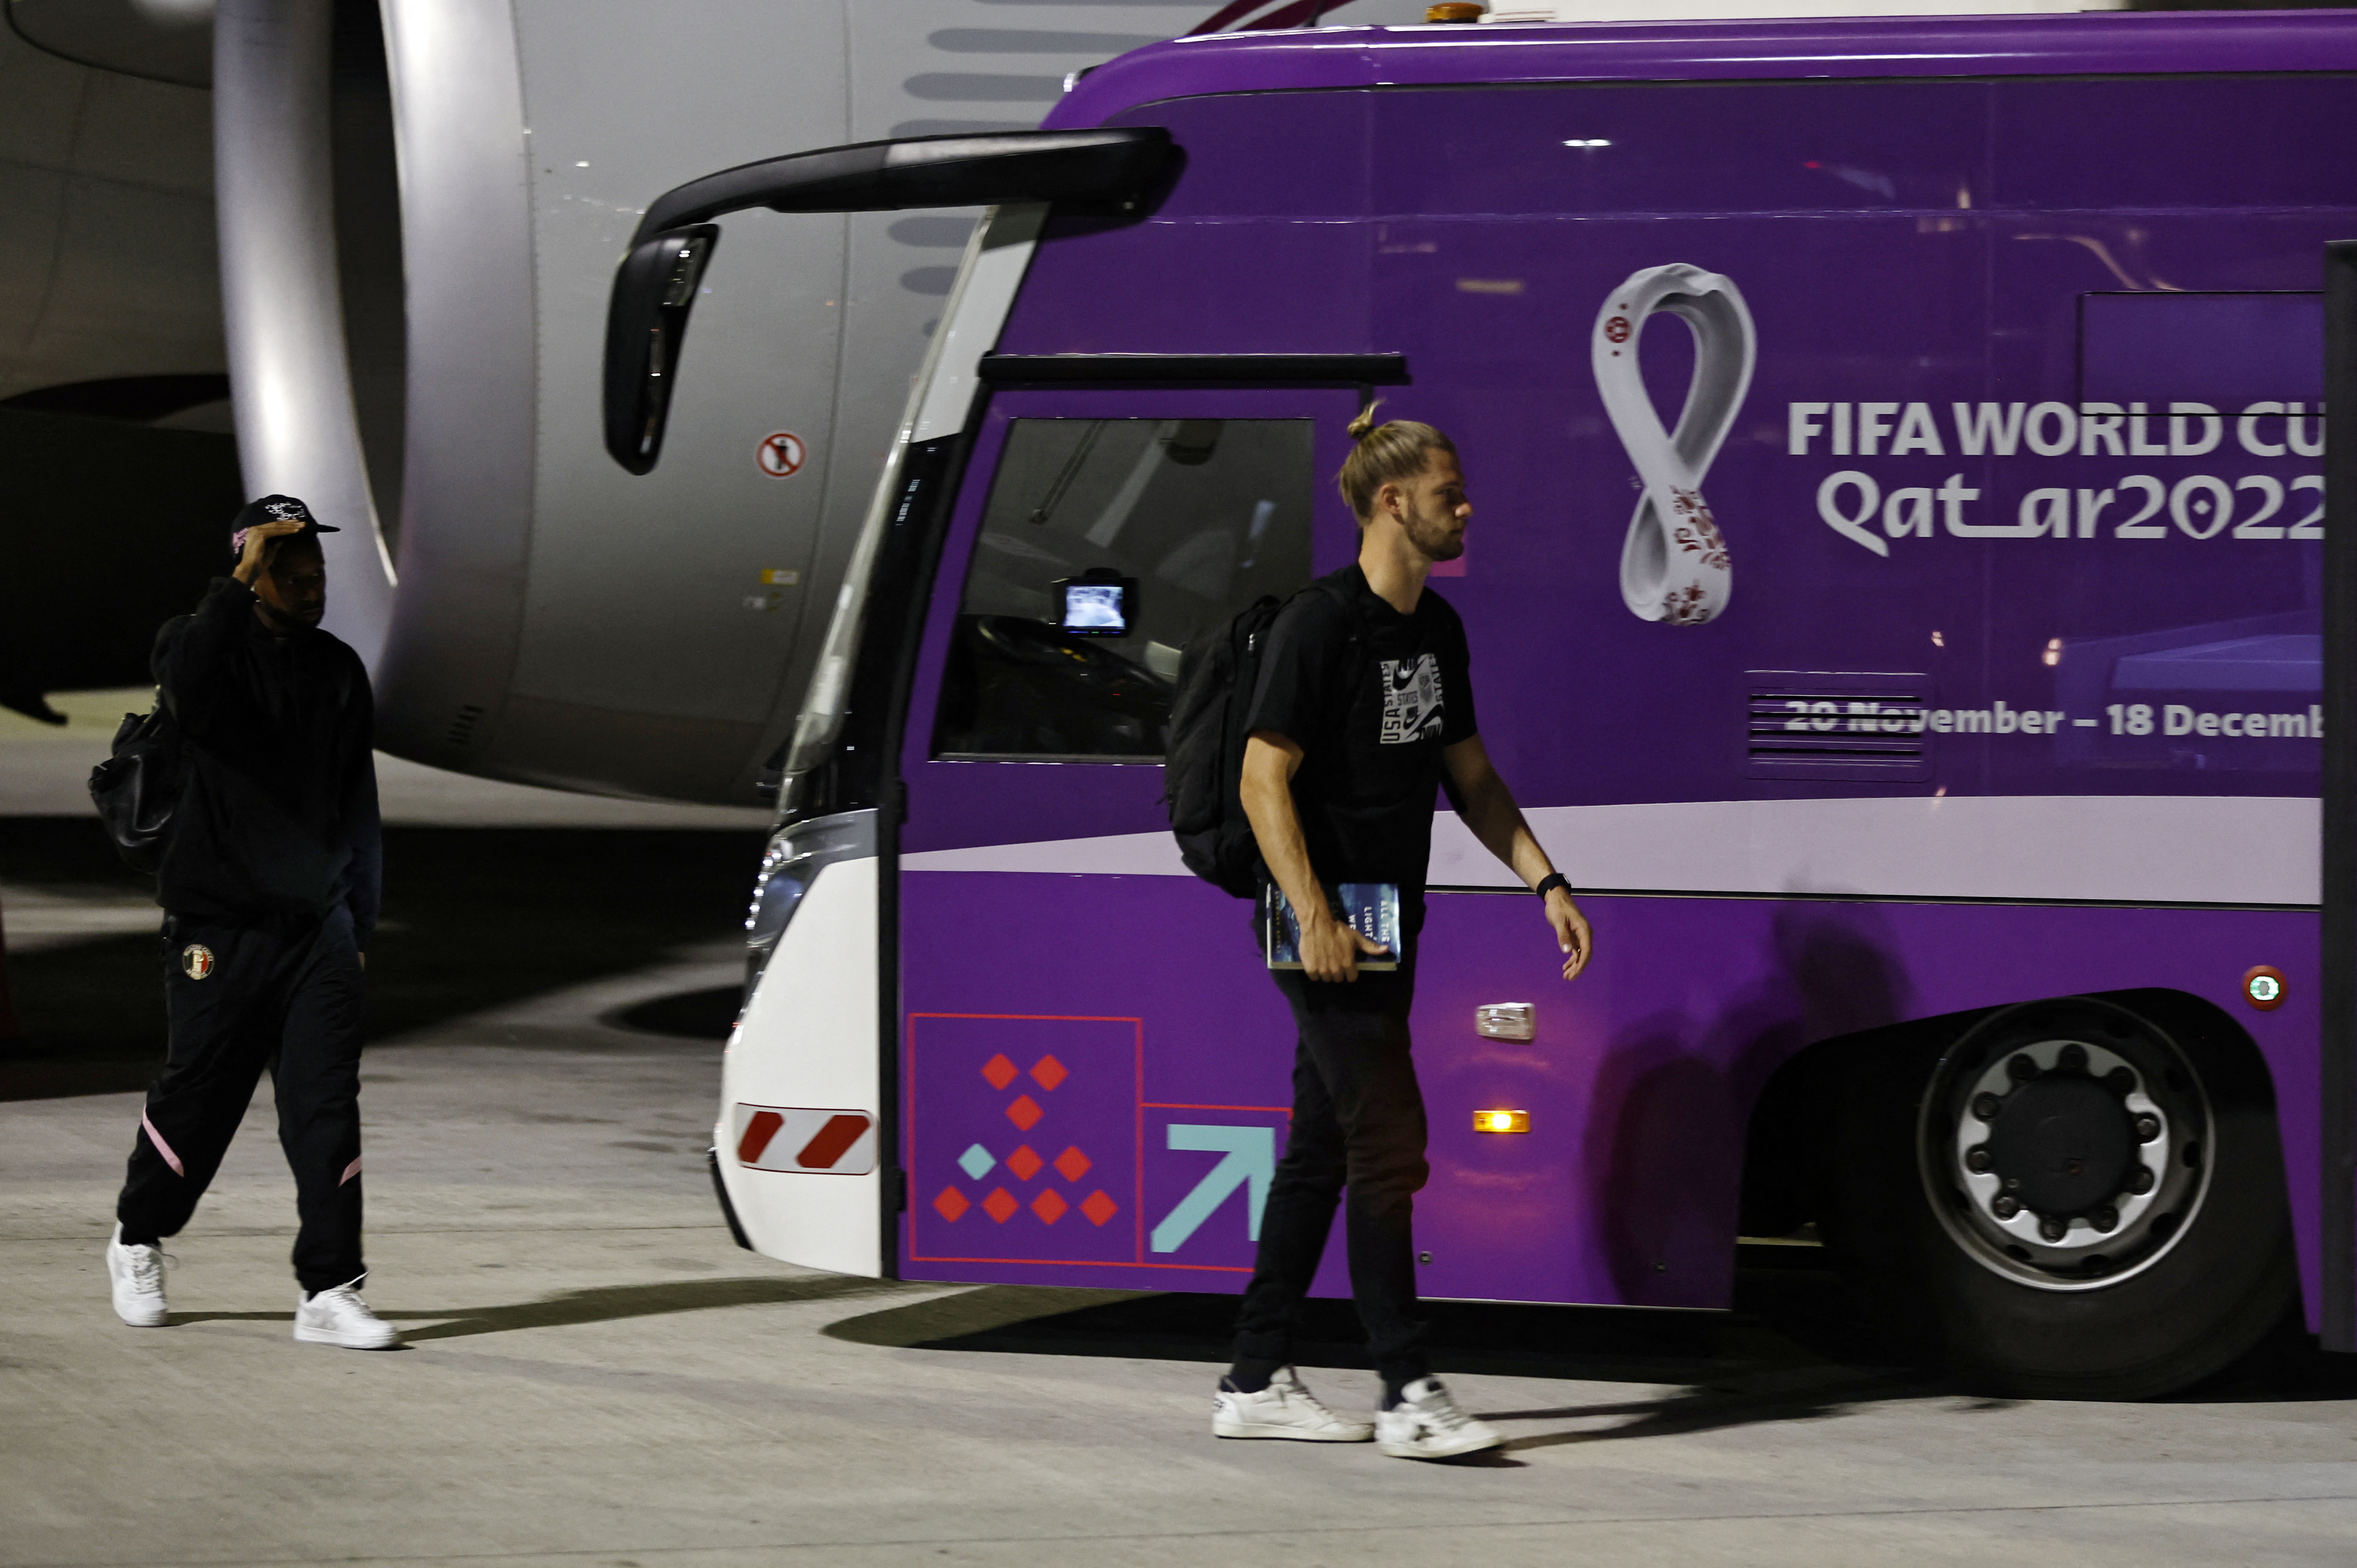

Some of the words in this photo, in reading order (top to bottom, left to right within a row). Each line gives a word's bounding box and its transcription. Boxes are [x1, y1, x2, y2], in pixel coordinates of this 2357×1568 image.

[1788, 402, 1945, 456] FIFA
[1951, 401, 2224, 457] WORLD
[1382, 707, 1400, 741] USA
[1783, 700, 1839, 732] 20
[1846, 700, 2065, 734] November
[2106, 703, 2155, 736] 18
[1364, 906, 1373, 939] LIGHT
[1380, 900, 1388, 919] ALL
[1381, 923, 1390, 943] THE
